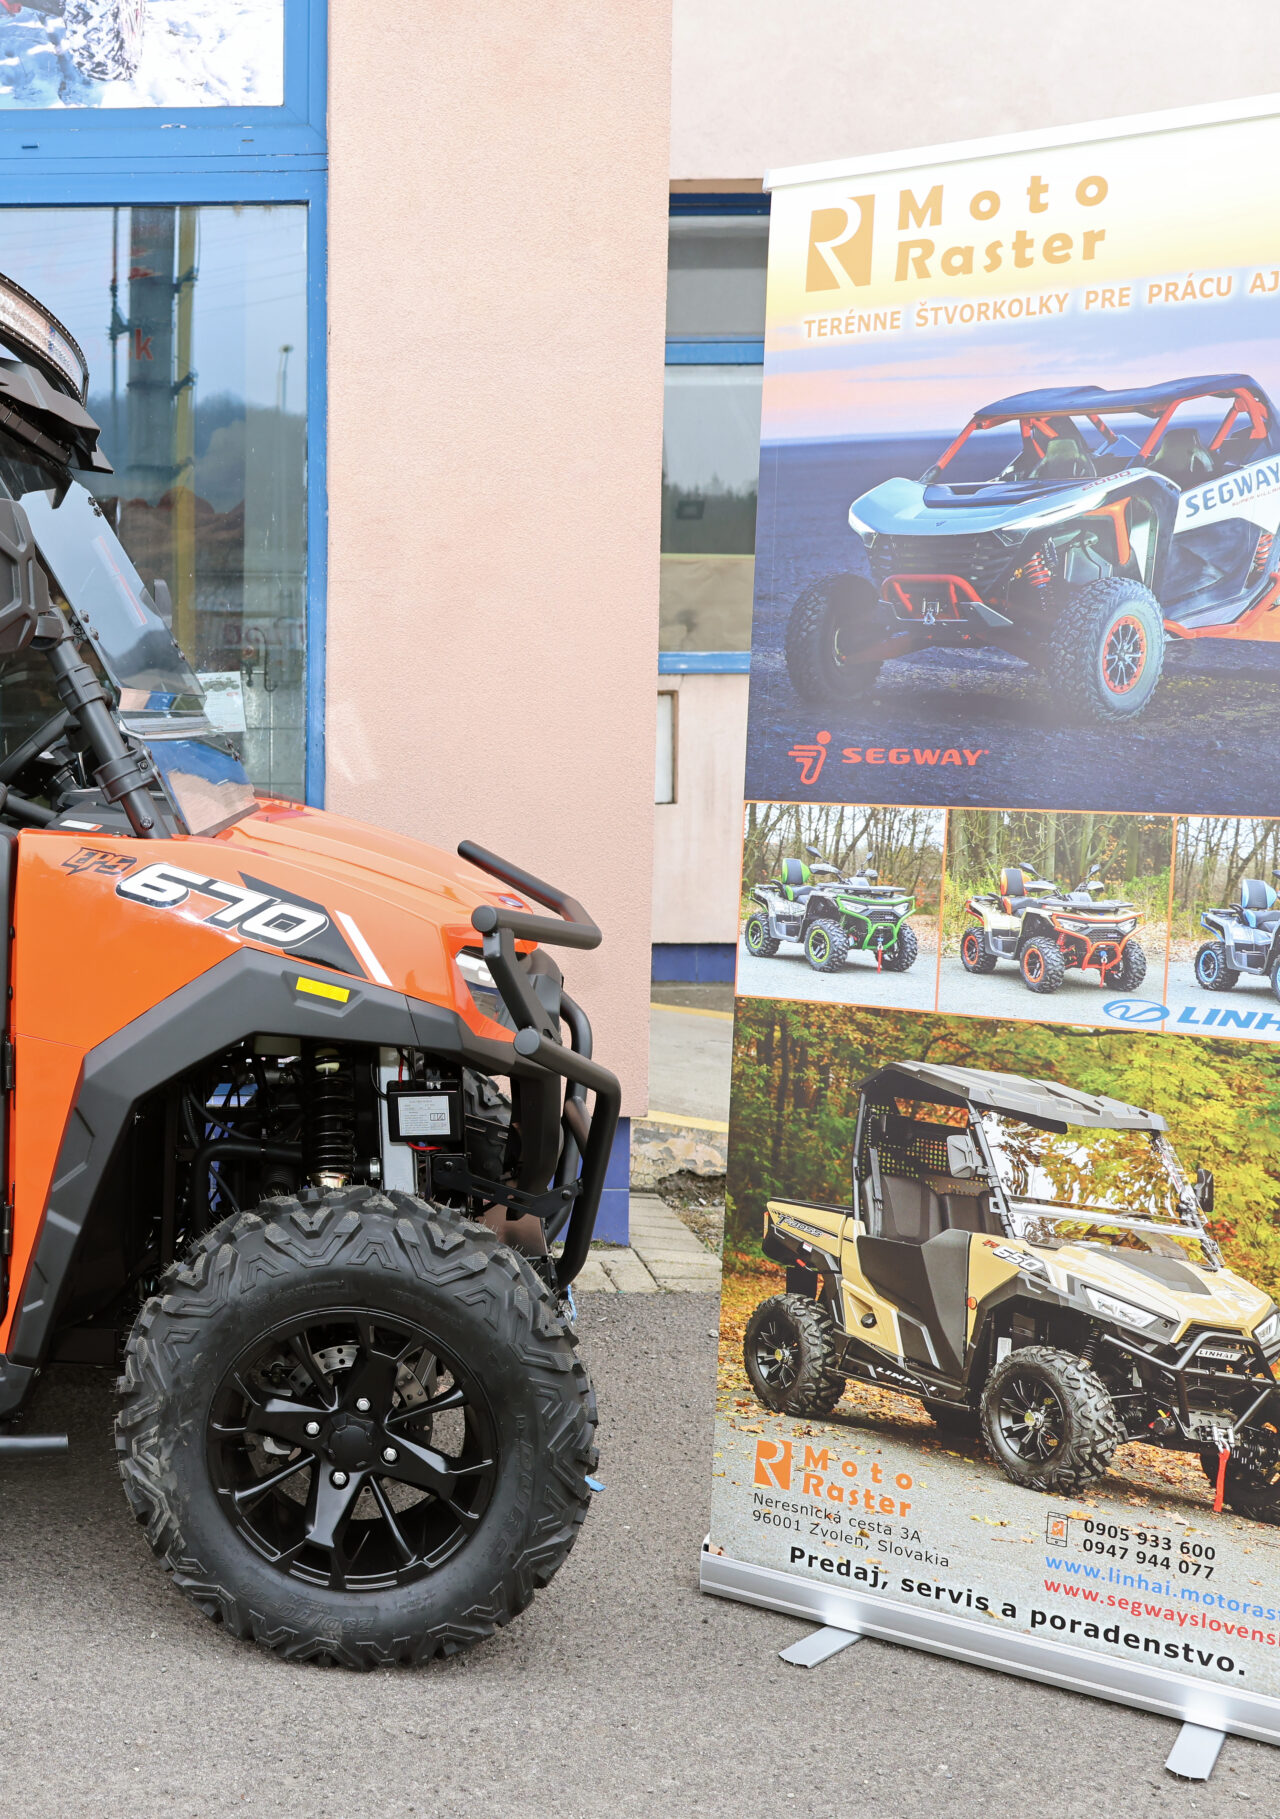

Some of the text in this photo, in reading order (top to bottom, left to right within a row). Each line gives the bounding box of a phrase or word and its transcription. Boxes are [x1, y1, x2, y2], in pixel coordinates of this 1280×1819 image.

[897, 175, 1109, 230] Moto
[895, 229, 1106, 281] Raster
[805, 310, 900, 338] TERÉNNE
[915, 293, 1069, 328] ŠTVORKOLKY
[1085, 287, 1130, 310] PRE
[1148, 273, 1232, 304] PRÁCU
[842, 747, 982, 765] SEGWAY
[62, 848, 137, 876] EPS
[115, 862, 329, 948] 670
[993, 1247, 1045, 1271] 650
[1199, 1349, 1235, 1360] LINHAI
[804, 1445, 913, 1491] Moto
[803, 1475, 913, 1518] Raster
[753, 1510, 950, 1567] 96001 Zvolen, Slovakia
[848, 1514, 894, 1536] cesta
[900, 1527, 921, 1543] 3A
[1084, 1520, 1216, 1560] 0905 933 600
[1083, 1538, 1215, 1580] 0947 944 077
[789, 1546, 1246, 1676] Predaj, servis a poradenstvo.
[1044, 1576, 1280, 1646] www.segwayslovens
